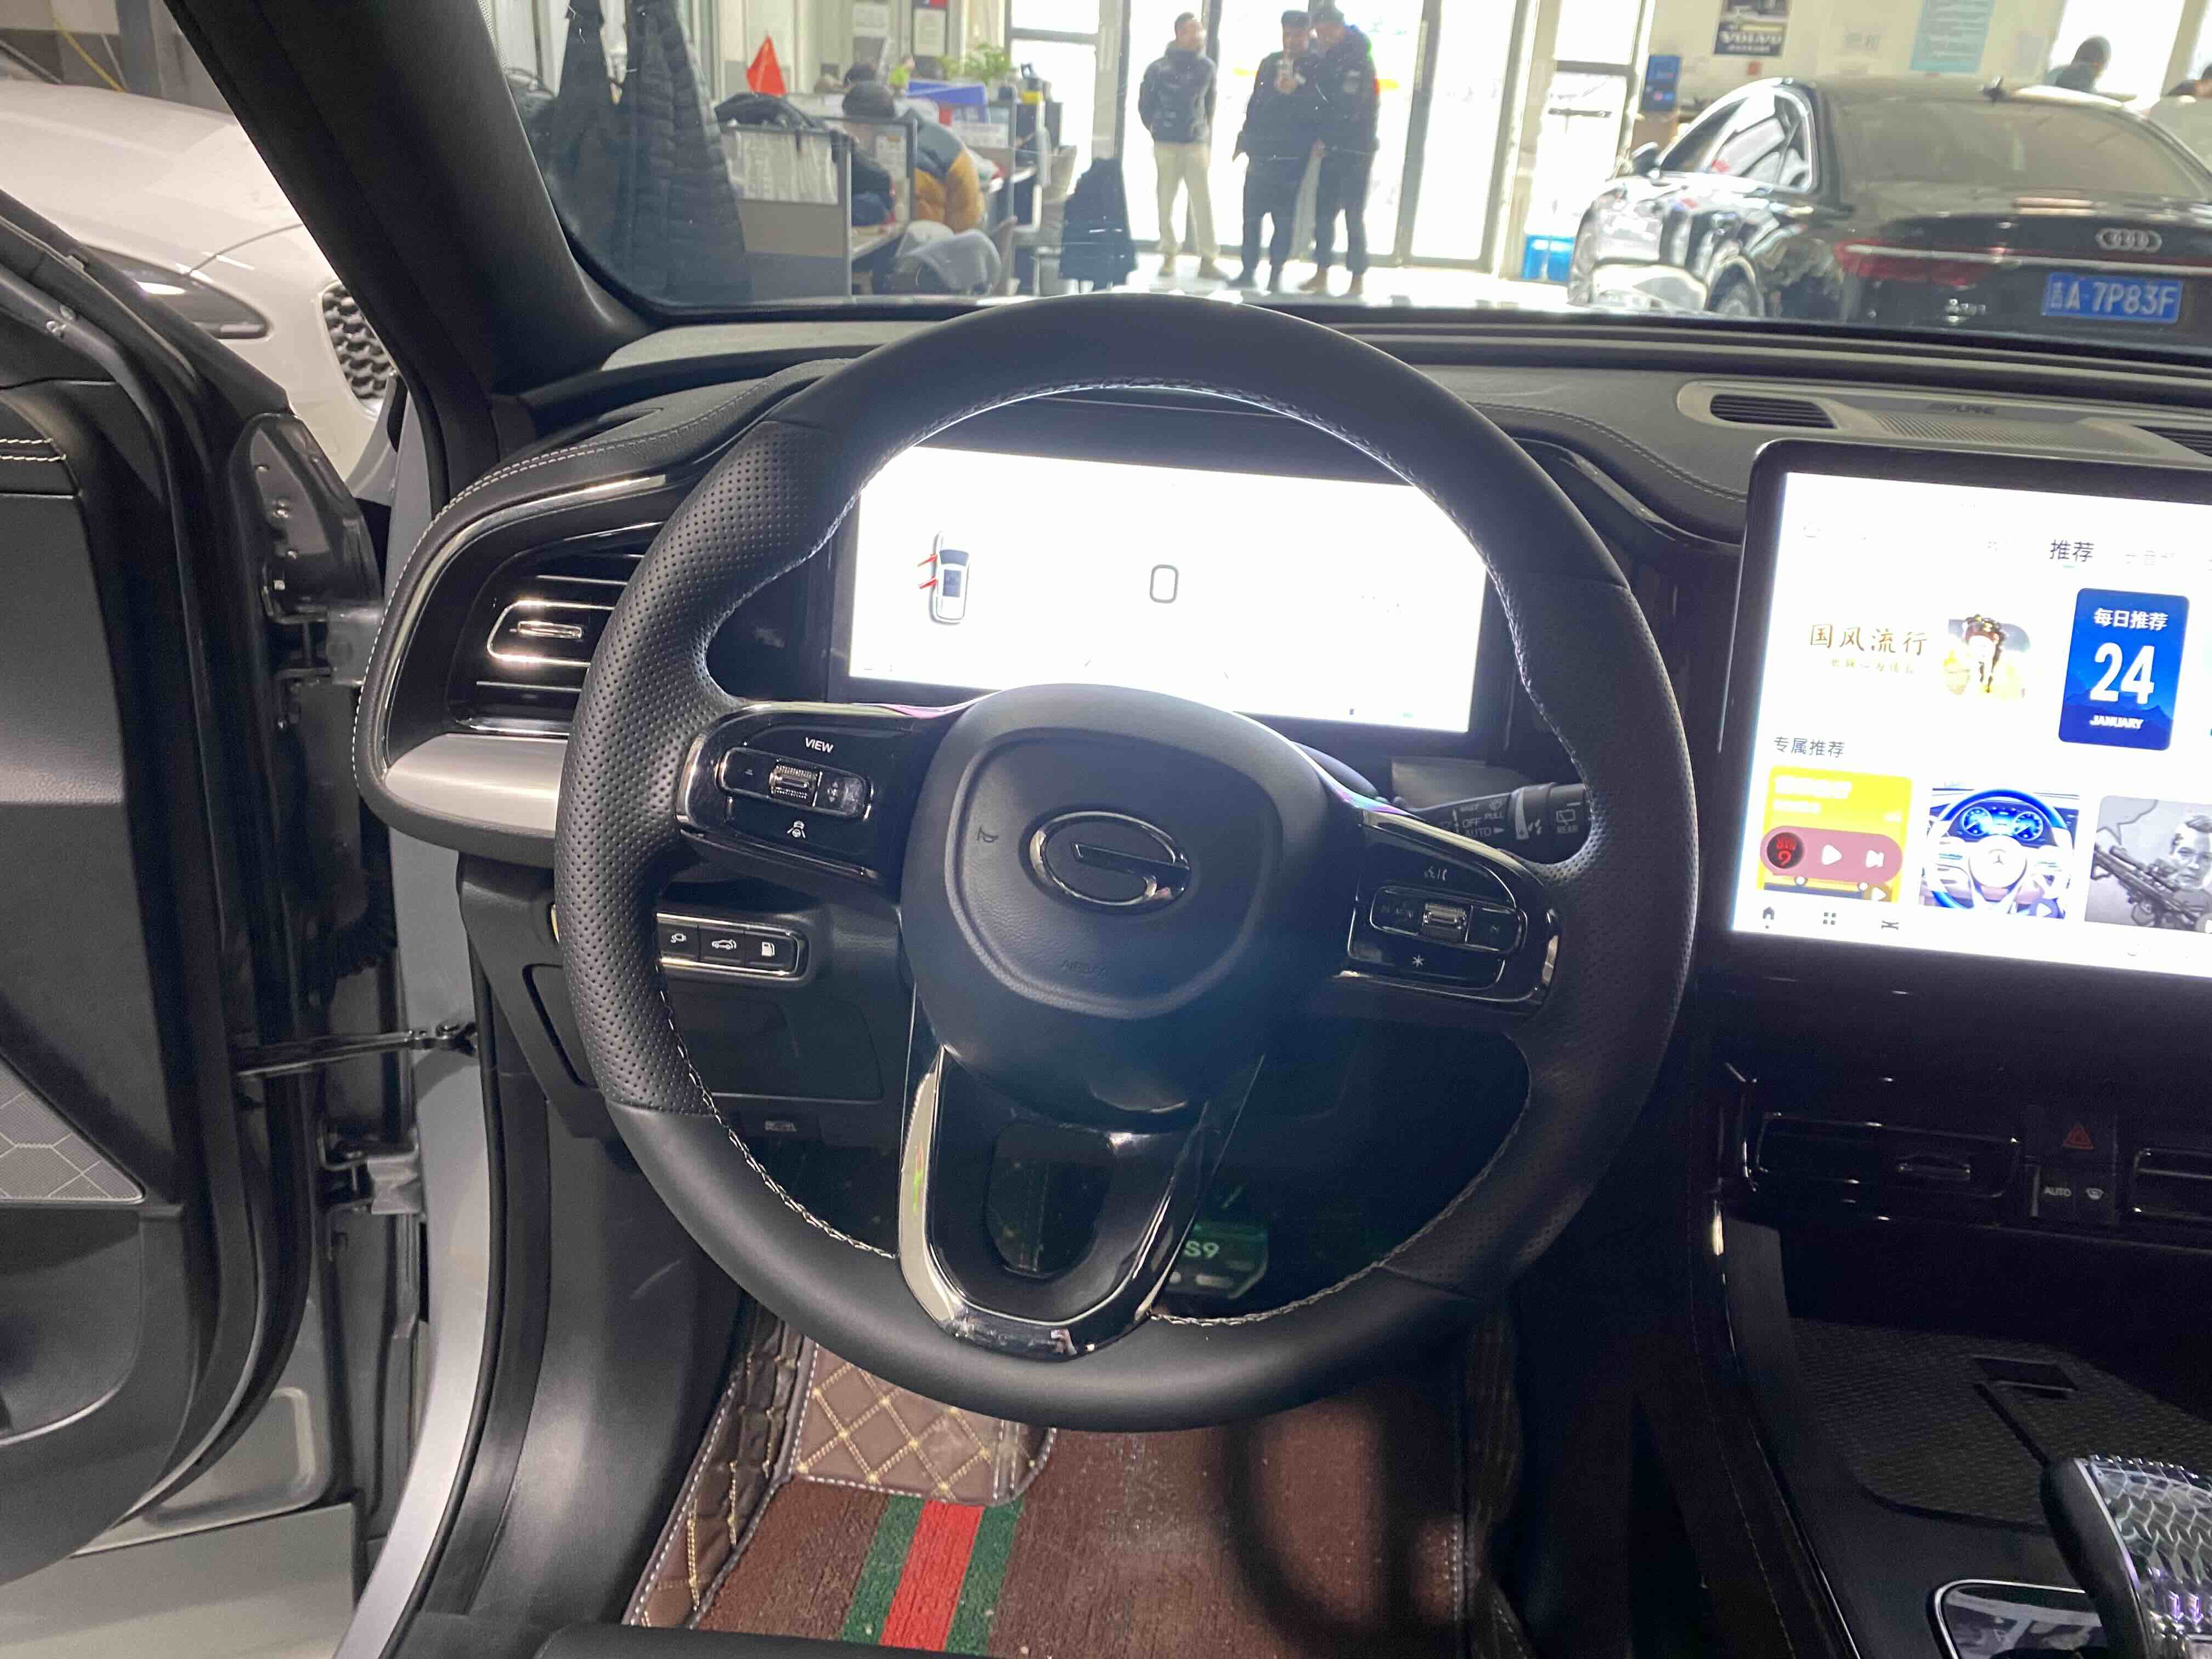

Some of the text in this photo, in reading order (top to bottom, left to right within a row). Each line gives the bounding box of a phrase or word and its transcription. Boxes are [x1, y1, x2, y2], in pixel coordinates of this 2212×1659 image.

[2050, 539, 2095, 562] 推荐
[2094, 607, 2169, 631] 每日推荐
[1810, 623, 1928, 657] 国风流行
[2089, 642, 2156, 704] 24
[2089, 715, 2144, 729] JANUARY
[804, 737, 834, 753] VIEW
[1773, 735, 1845, 759] 专属推荐
[1462, 817, 1481, 828] OFF
[1465, 826, 1492, 837] AUTO
[2044, 1186, 2072, 1197] AUTO
